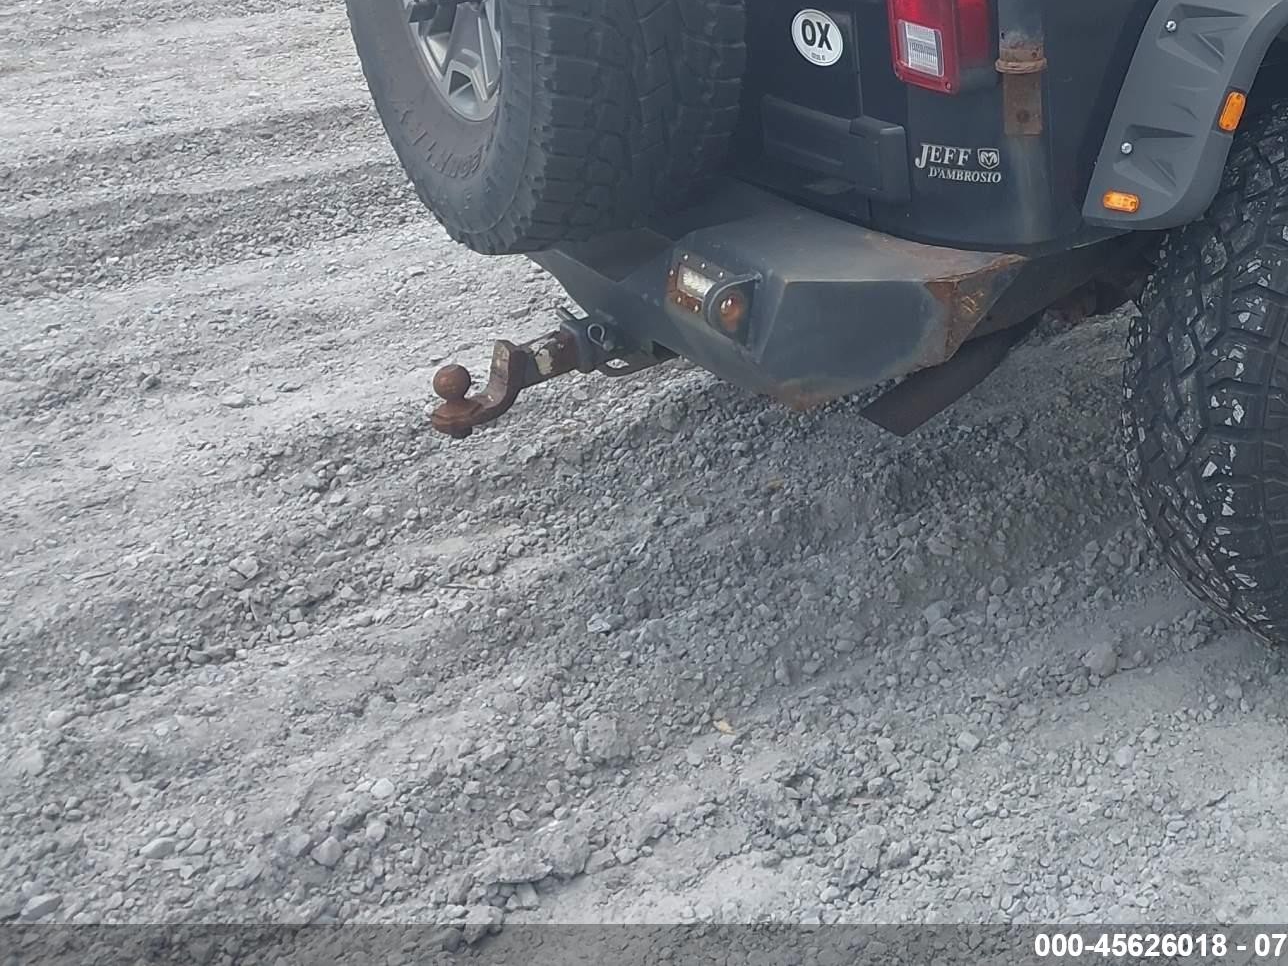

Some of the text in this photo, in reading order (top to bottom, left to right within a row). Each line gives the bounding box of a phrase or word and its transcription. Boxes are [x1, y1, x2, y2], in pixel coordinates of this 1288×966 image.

[801, 18, 833, 51] OX
[914, 143, 972, 169] JEFF
[928, 167, 1002, 183] D'AMBROSIO
